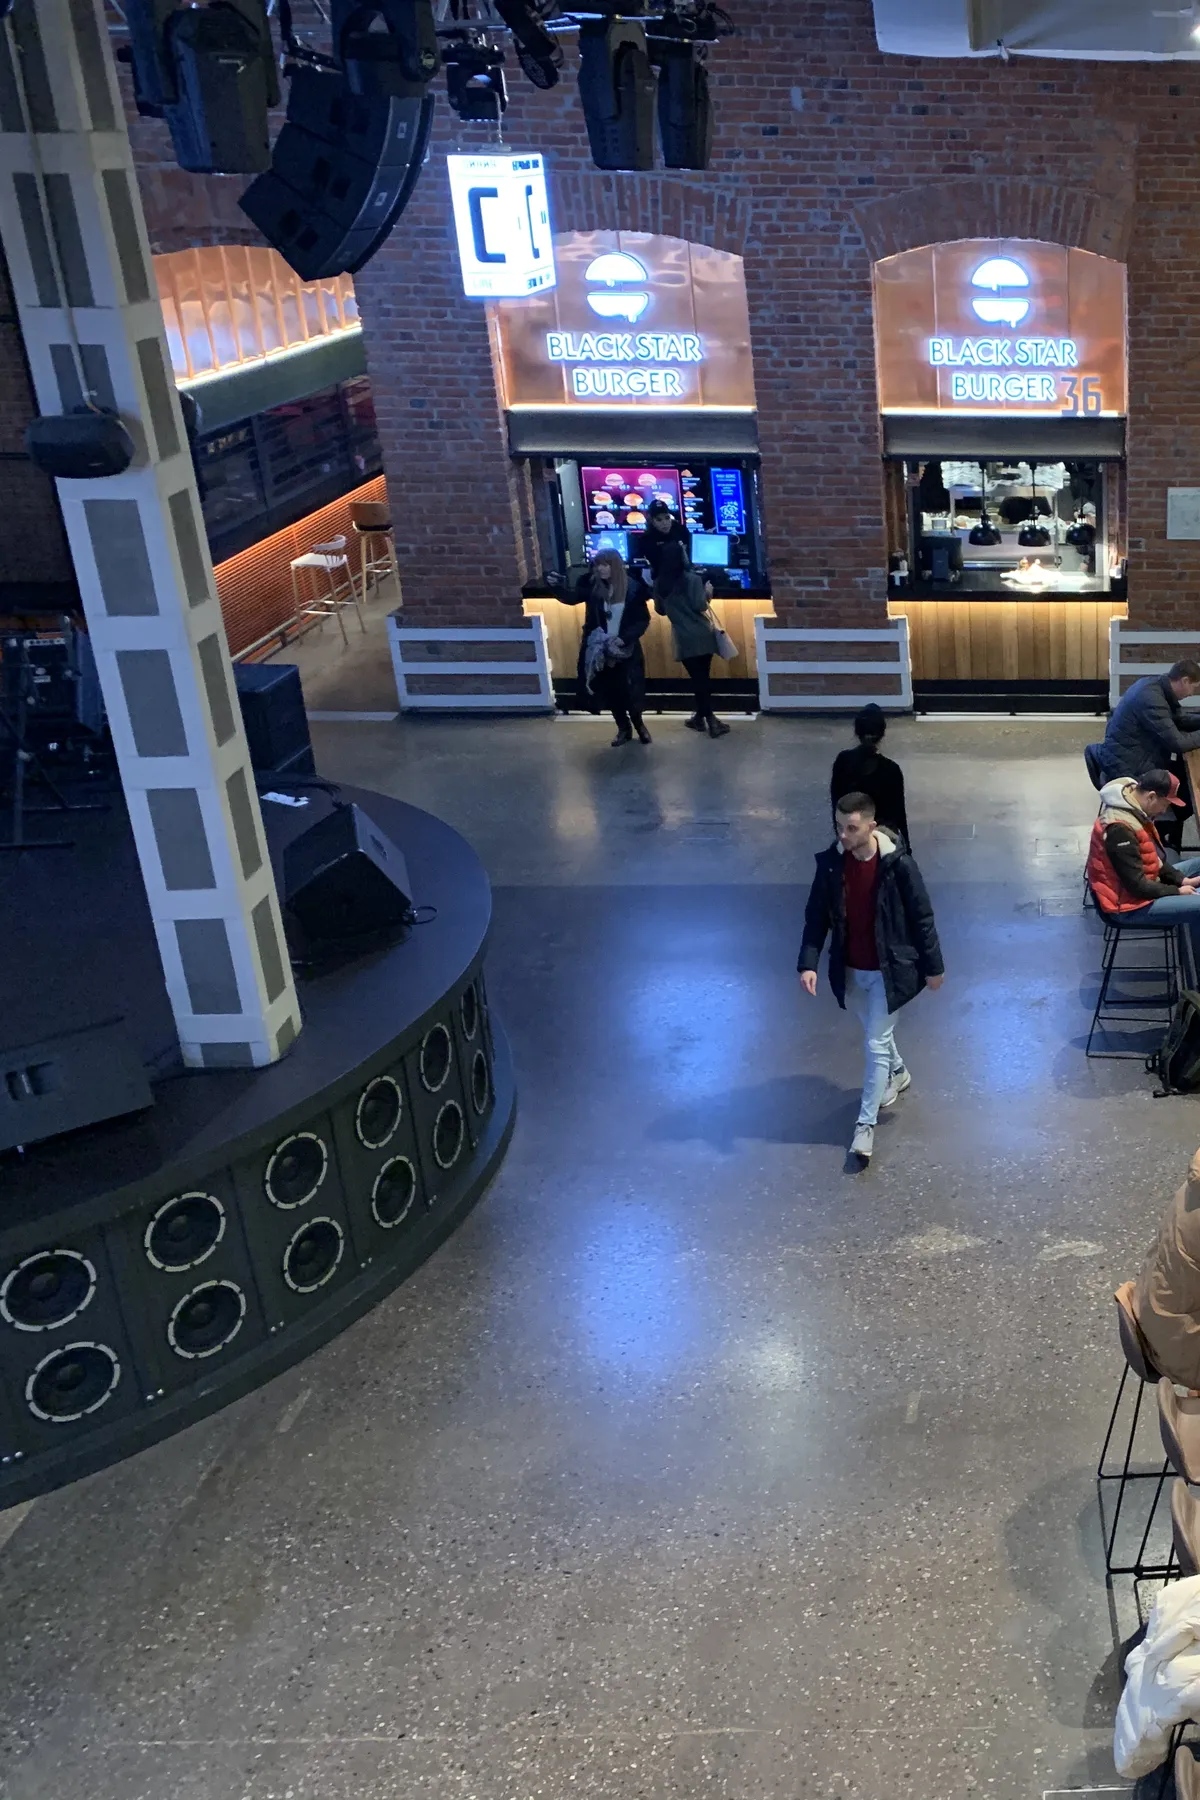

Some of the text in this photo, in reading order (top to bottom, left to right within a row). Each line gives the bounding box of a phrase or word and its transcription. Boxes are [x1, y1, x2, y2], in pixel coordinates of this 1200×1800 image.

[546, 332, 703, 362] BLACK STAR
[929, 337, 1079, 368] BLACK STAR
[572, 368, 684, 397] BURGER
[952, 373, 1058, 402] BURGER
[1060, 376, 1102, 417] 36
